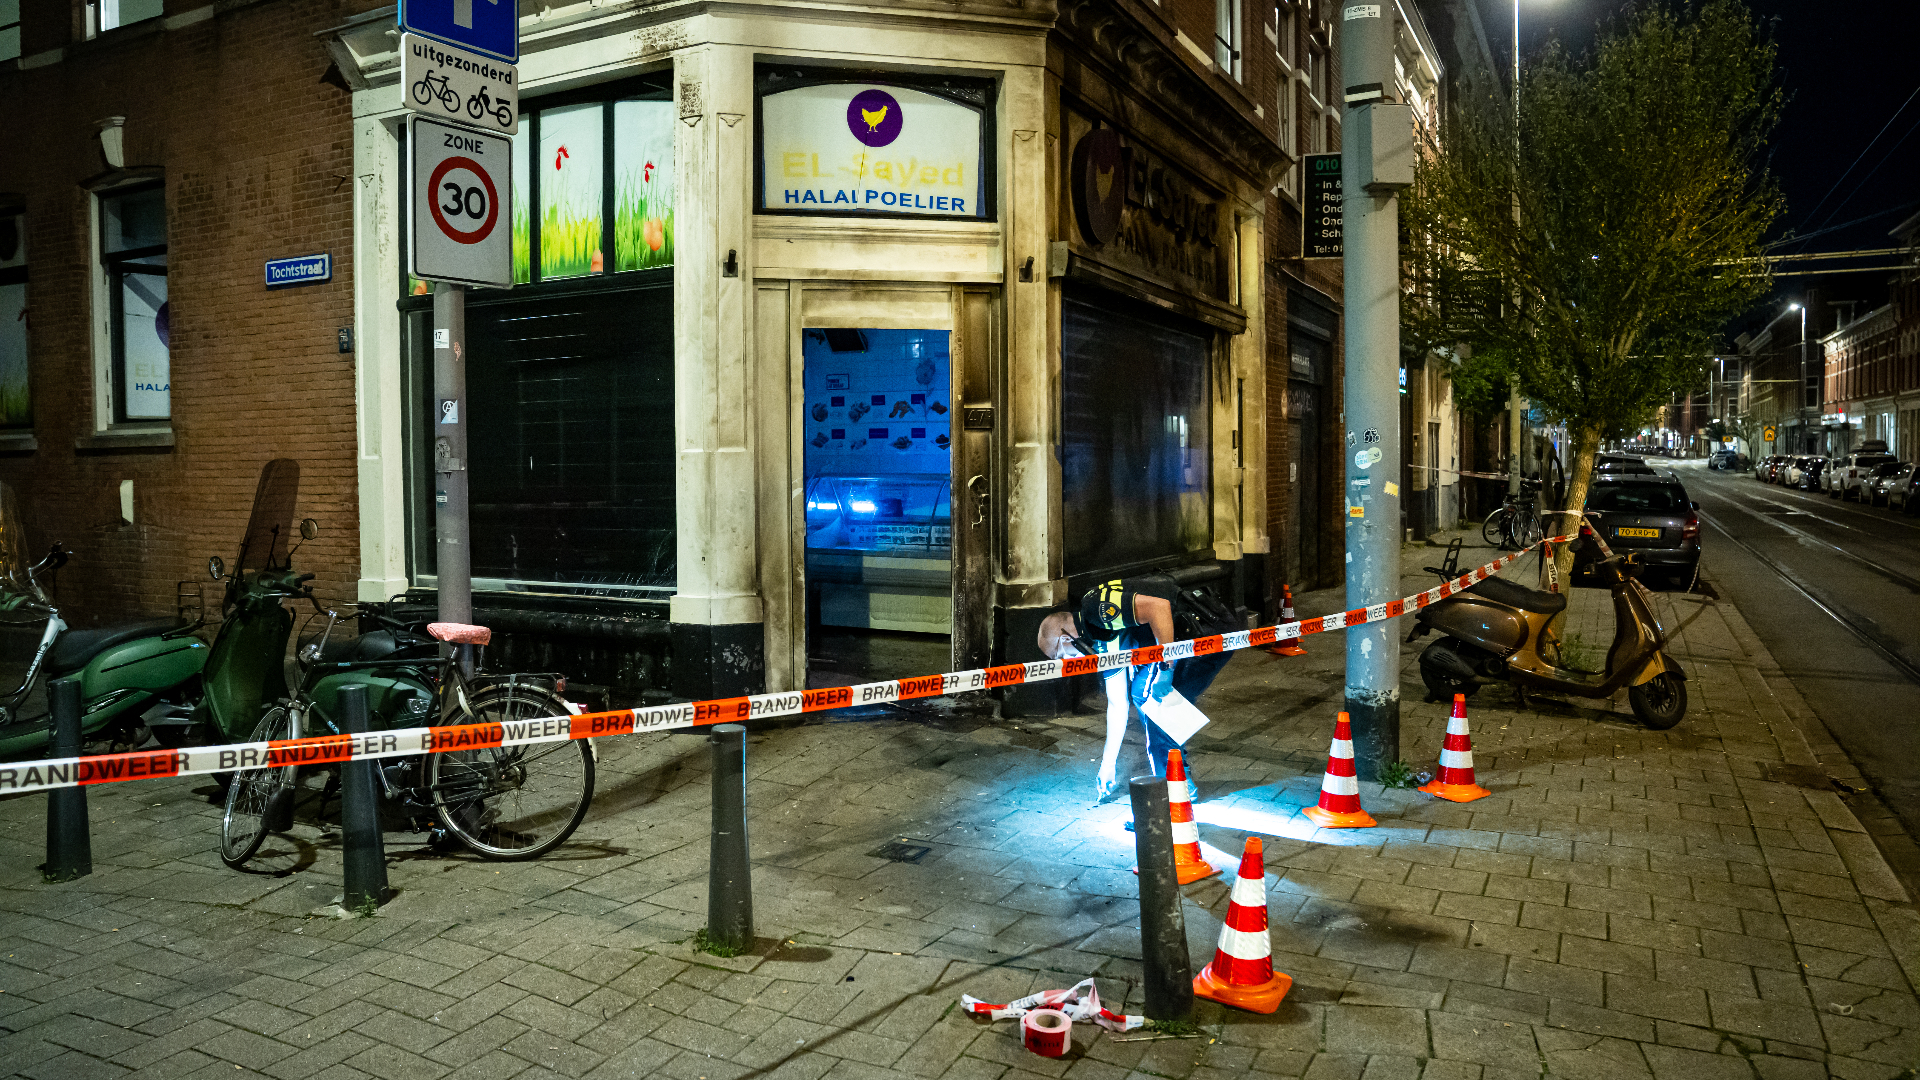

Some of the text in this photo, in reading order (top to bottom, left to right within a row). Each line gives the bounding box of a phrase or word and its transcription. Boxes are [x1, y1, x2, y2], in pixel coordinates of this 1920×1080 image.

[413, 43, 513, 85] uitgezonderd
[444, 133, 484, 154] ZONE
[1322, 180, 1332, 189] In
[442, 182, 486, 220] 30
[785, 188, 966, 213] HALAL POELIER
[1322, 192, 1343, 203] Rep
[1321, 229, 1343, 238] Sch
[1314, 245, 1331, 254] Tel:
[270, 260, 324, 279] Tochtstraat
[1343, 602, 1388, 625] BRANDWEER
[1222, 627, 1280, 649] BRANDWEER
[1286, 617, 1338, 637] BRANDWEER
[1148, 638, 1214, 660] BRANDWEER
[1066, 649, 1139, 674] BRANDWEER
[971, 662, 1056, 687] BRANDWEER
[862, 675, 959, 701] BRANDWEER
[737, 688, 850, 718] BRANDWEER
[591, 703, 721, 733] BRANDWEER
[420, 718, 572, 751] BRANDWEER
[219, 733, 397, 770] BRANDWEER
